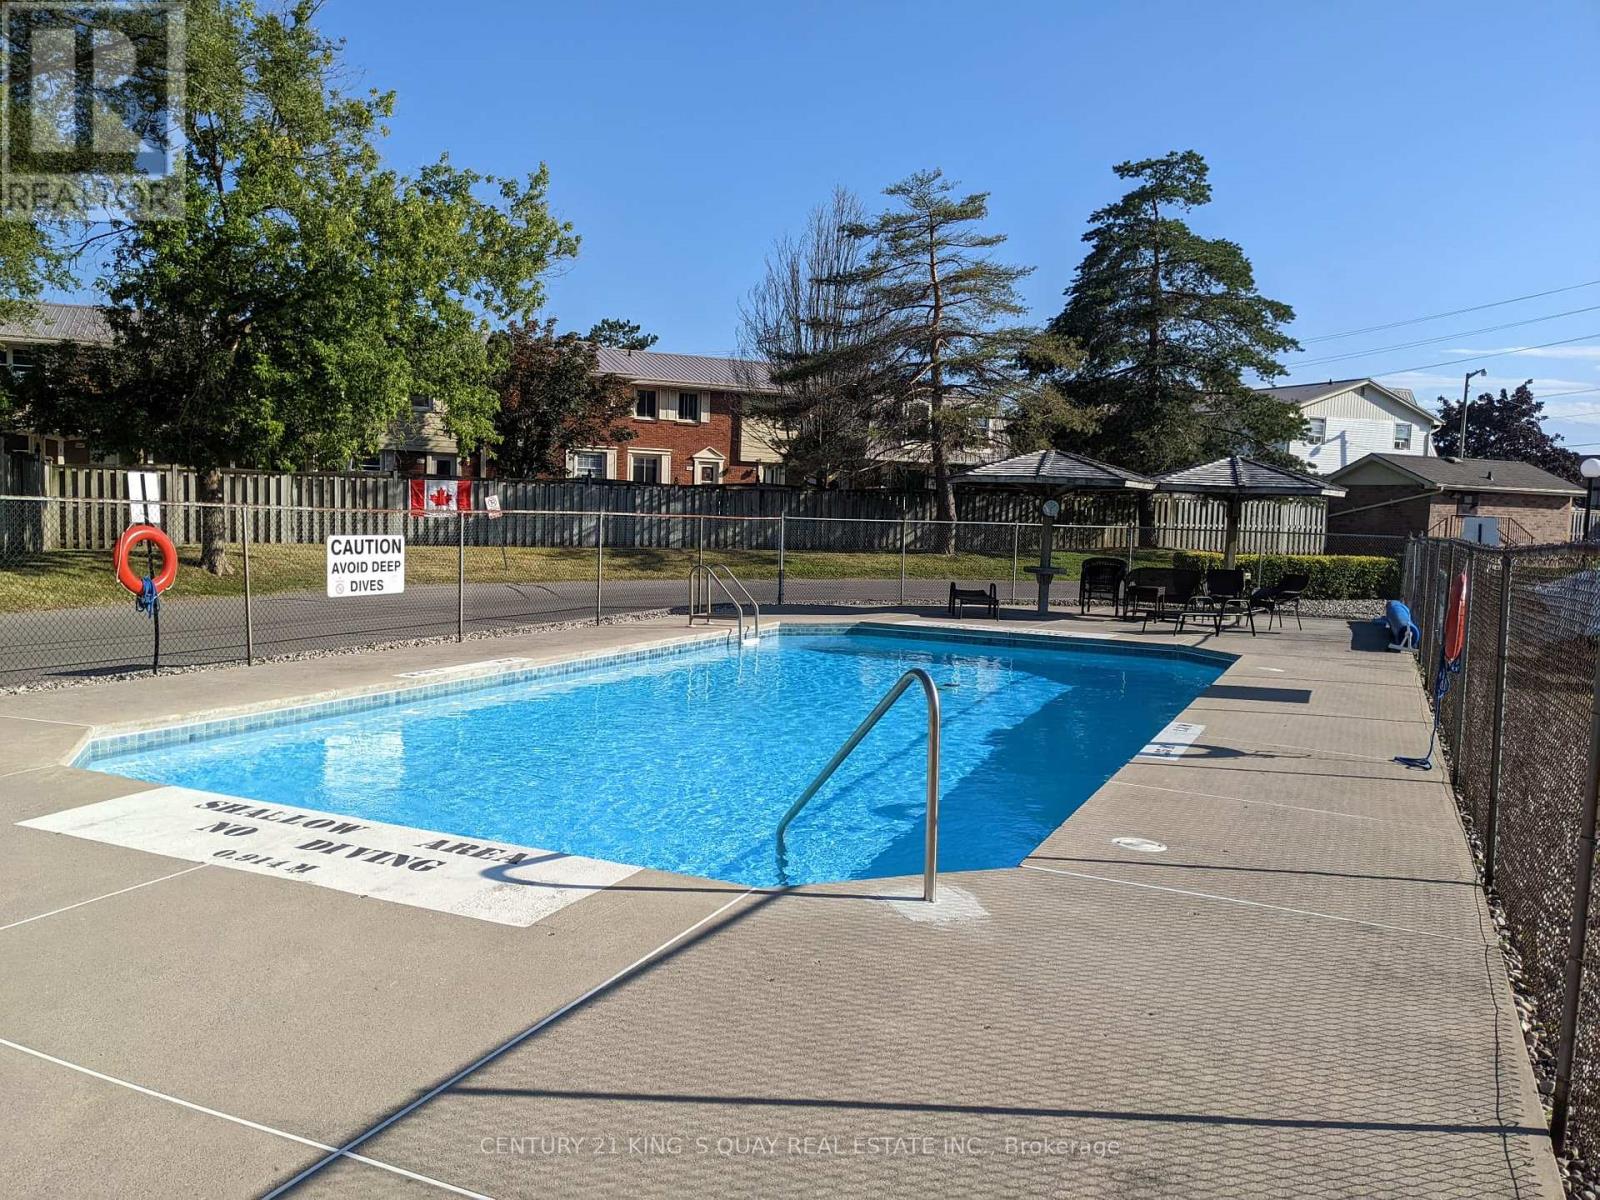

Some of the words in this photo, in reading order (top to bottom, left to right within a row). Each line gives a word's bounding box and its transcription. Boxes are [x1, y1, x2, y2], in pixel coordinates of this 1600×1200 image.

[331, 539, 402, 555] CAUTION
[331, 561, 368, 574] AVOID
[372, 560, 401, 572] DEEP
[350, 579, 384, 592] DIVES
[194, 800, 370, 834] SHALLOW
[414, 840, 528, 864] AREA
[195, 821, 258, 836] NO
[295, 839, 446, 871] DIVING
